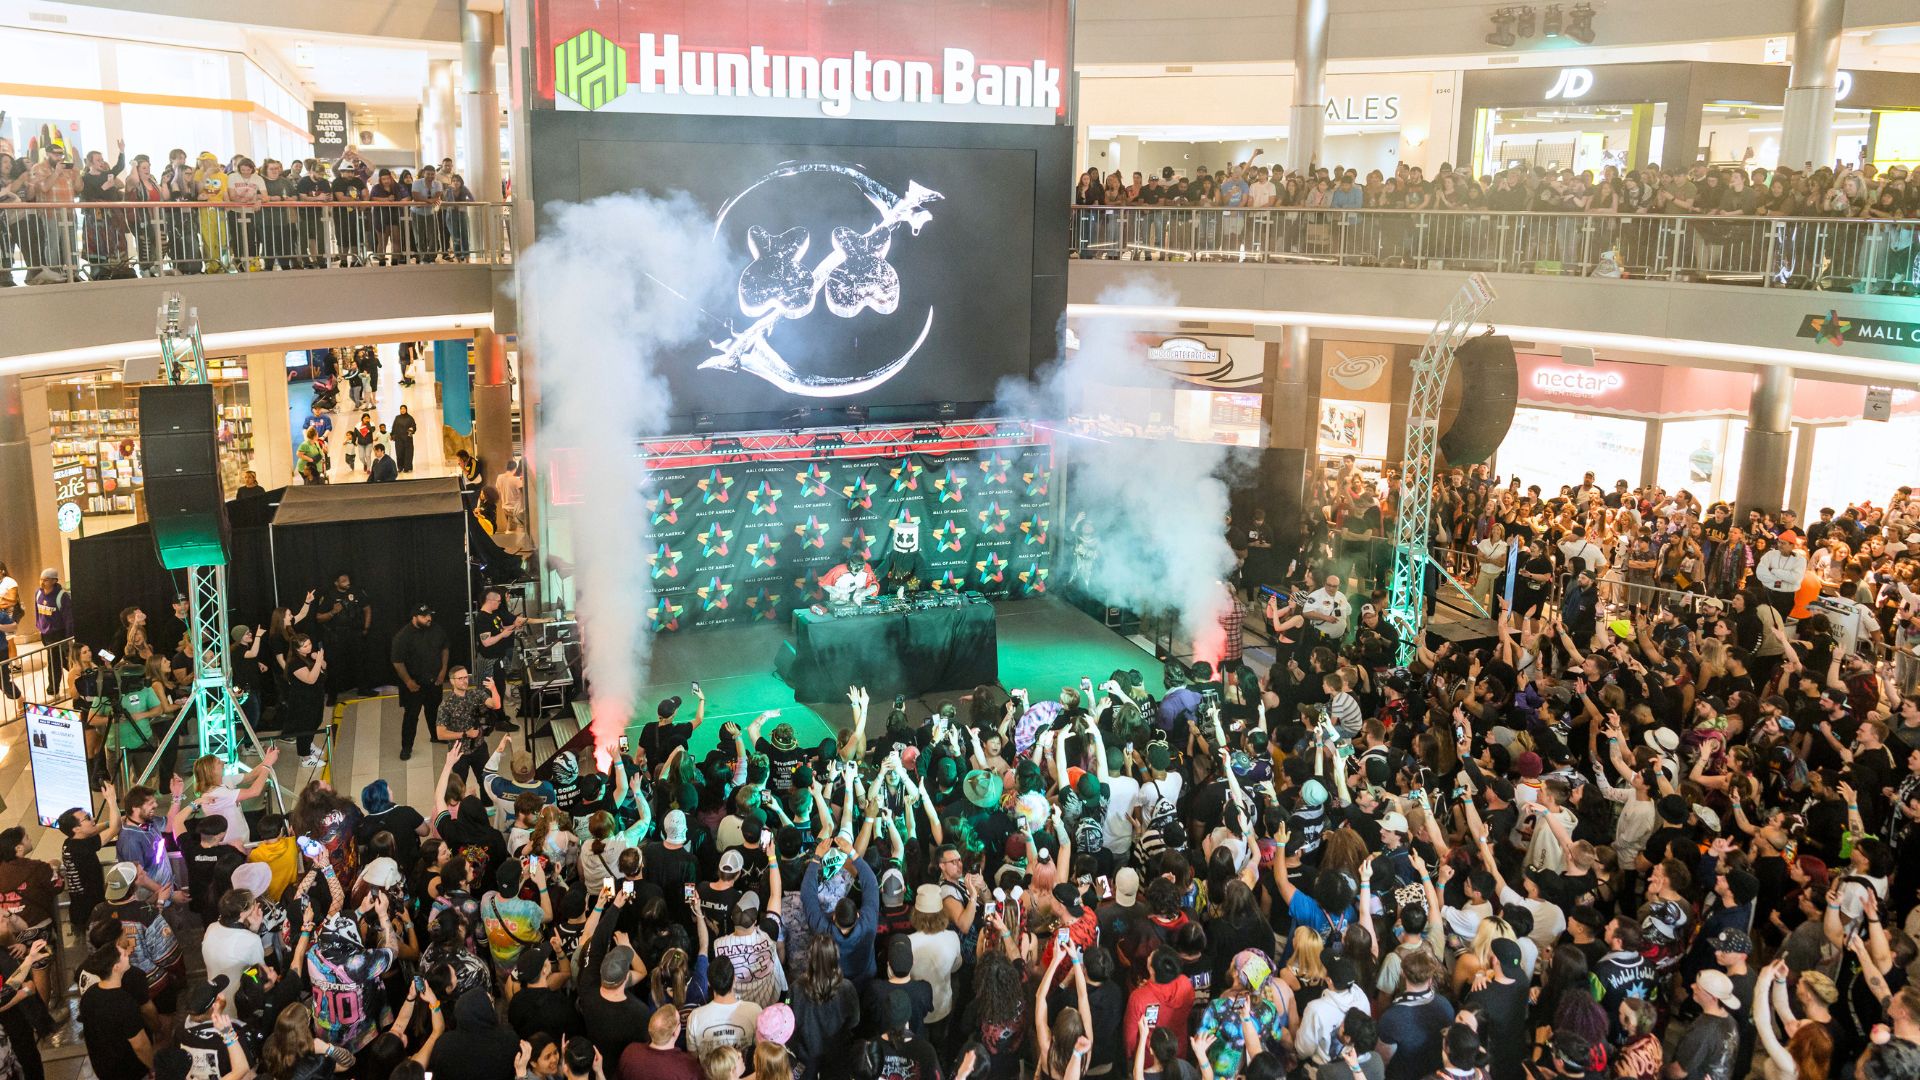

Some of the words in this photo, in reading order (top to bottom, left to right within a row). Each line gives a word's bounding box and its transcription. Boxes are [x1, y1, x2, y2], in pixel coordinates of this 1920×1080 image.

[639, 32, 933, 116] Huntington
[943, 47, 1060, 107] Bank
[1545, 68, 1594, 99] JD
[1325, 97, 1398, 120] ALES
[1858, 324, 1903, 341] MALL
[1536, 372, 1605, 391] nectar
